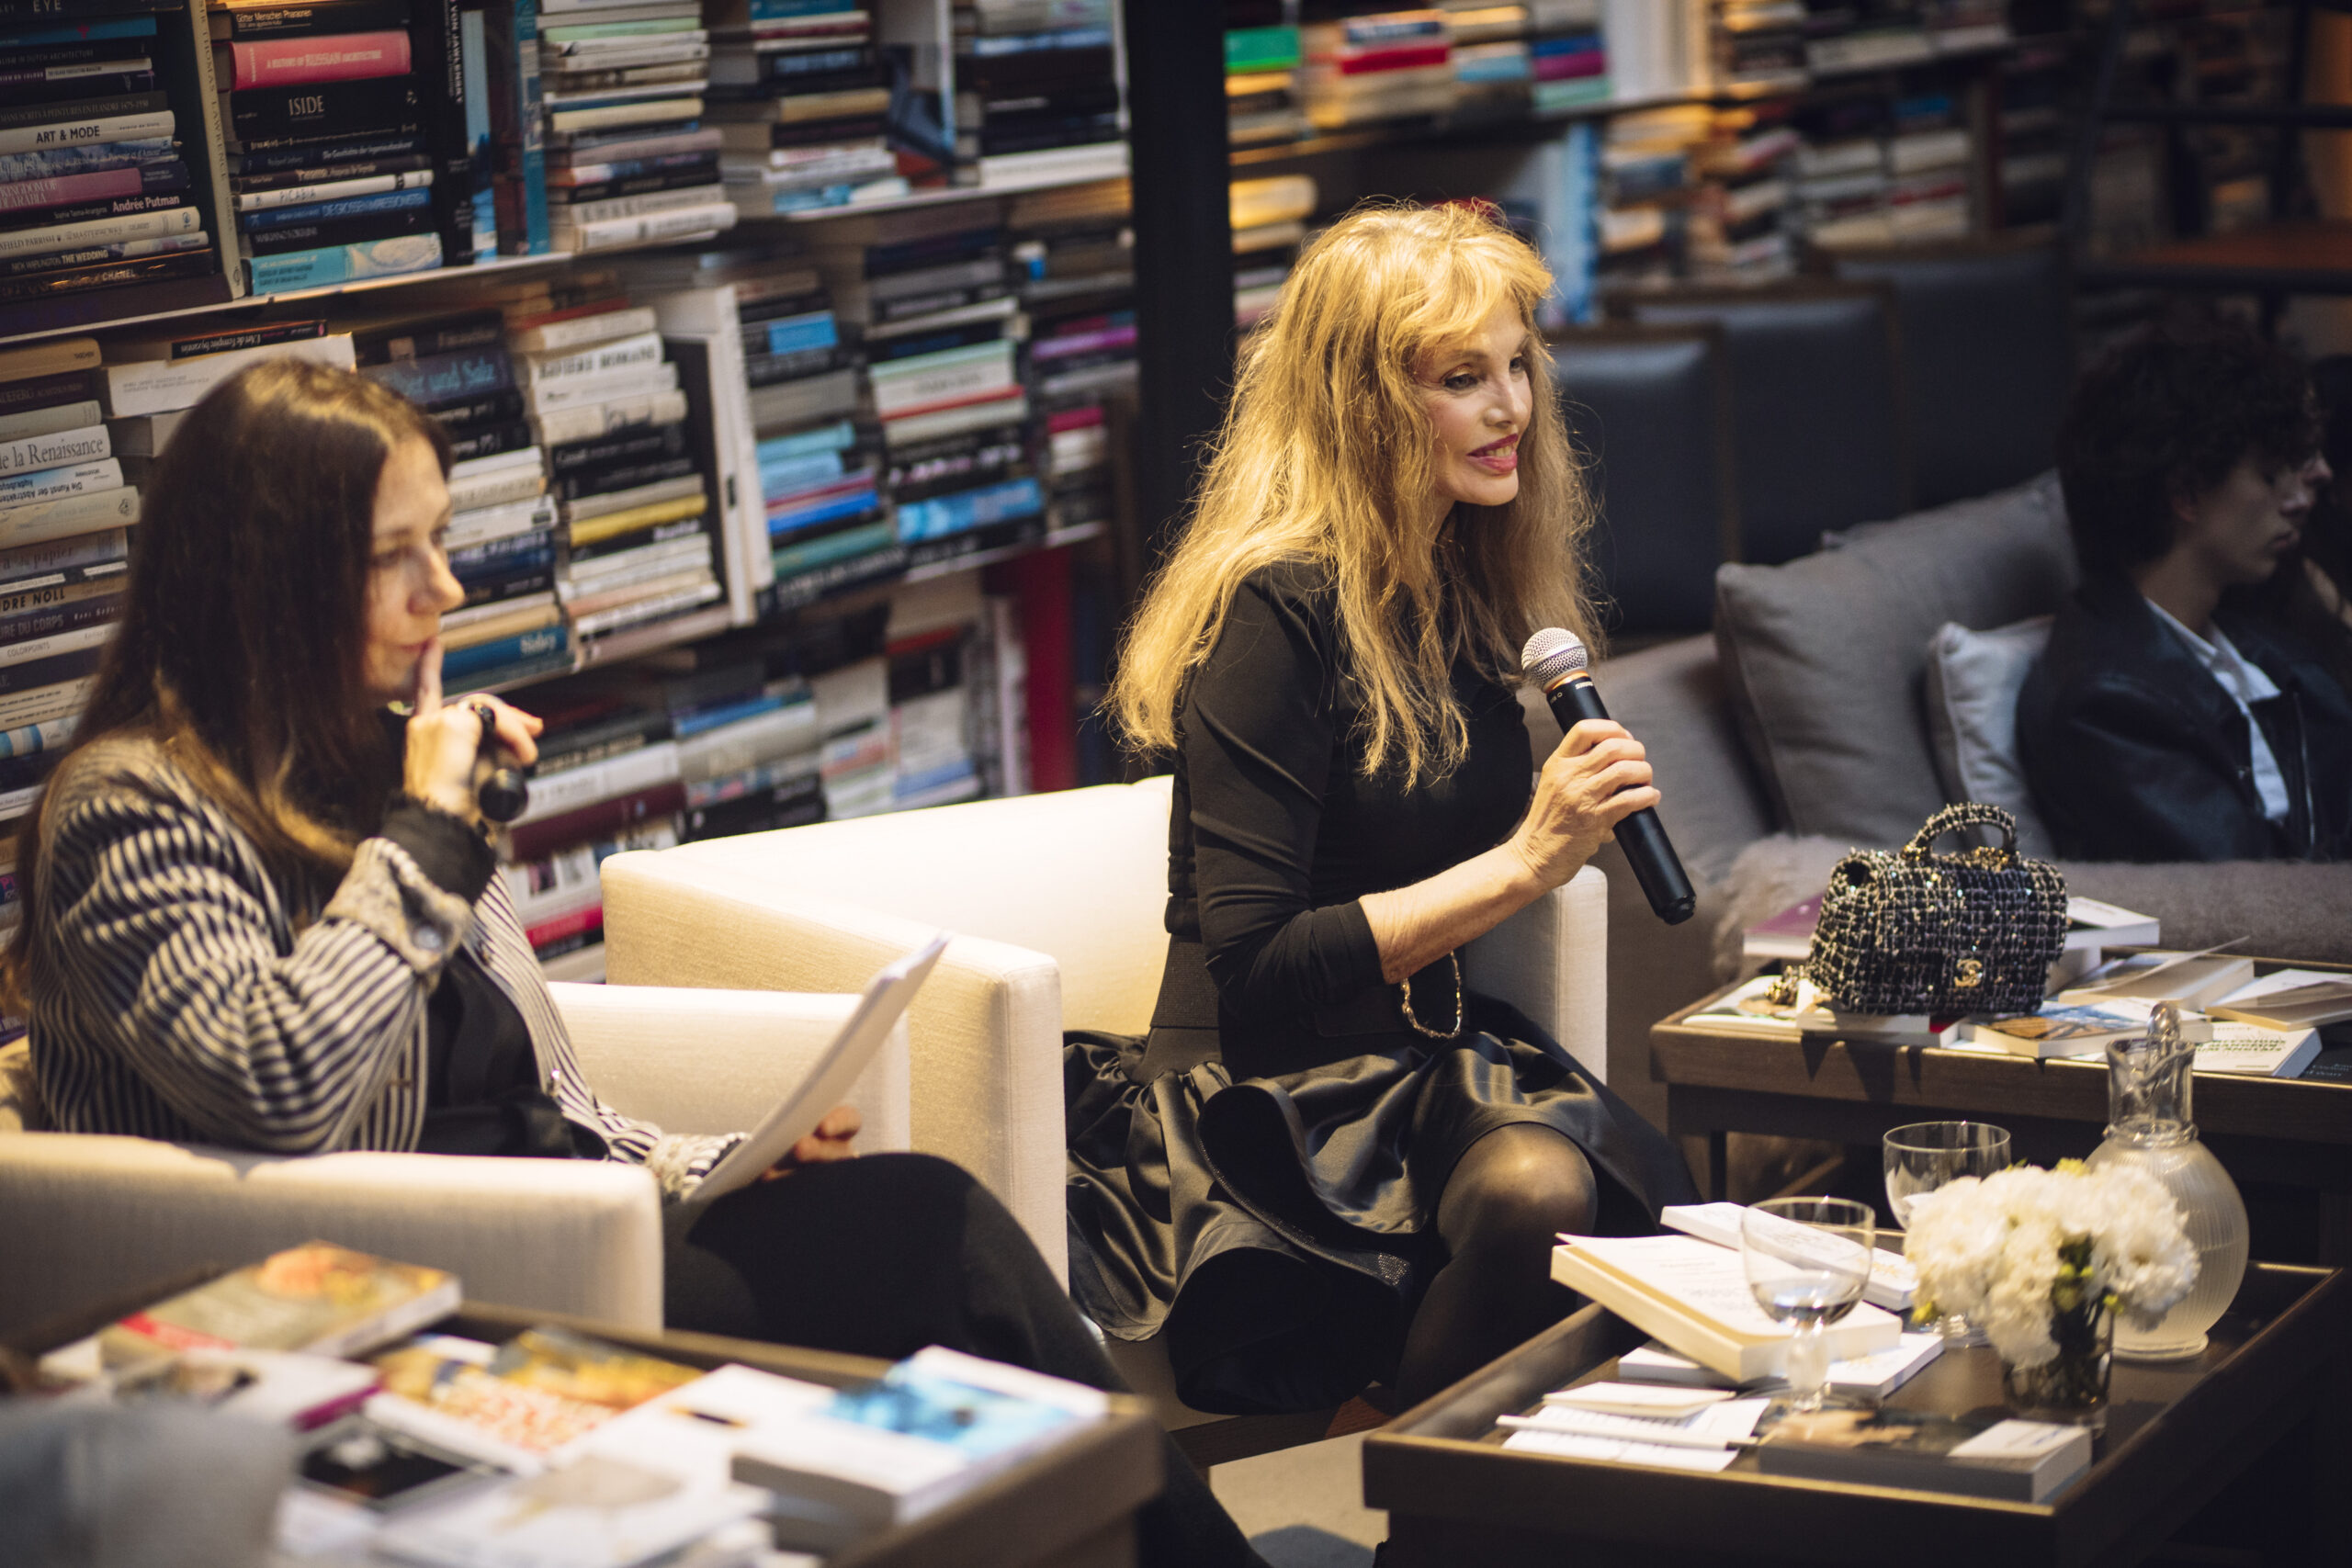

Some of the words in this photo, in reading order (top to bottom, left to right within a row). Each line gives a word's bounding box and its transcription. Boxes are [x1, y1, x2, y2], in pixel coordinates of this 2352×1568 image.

[33, 0, 62, 13] EYE
[288, 95, 325, 117] ISIDE
[36, 129, 58, 143] ART
[60, 130, 67, 141] &
[70, 125, 100, 139] MODE
[210, 100, 228, 181] LAWRENCE
[112, 197, 144, 212] Andrée
[145, 194, 180, 209] Putman
[62, 254, 76, 265] THE
[76, 249, 108, 264] WEDDING
[101, 268, 136, 281] CHANEL
[12, 446, 25, 468] la
[28, 436, 104, 465] Renaissance
[38, 488, 49, 497] der
[51, 483, 70, 495] Kunst
[3, 595, 26, 612] DRE
[33, 587, 65, 605] NOLL
[18, 620, 30, 636] DU
[33, 613, 64, 633] CORPS
